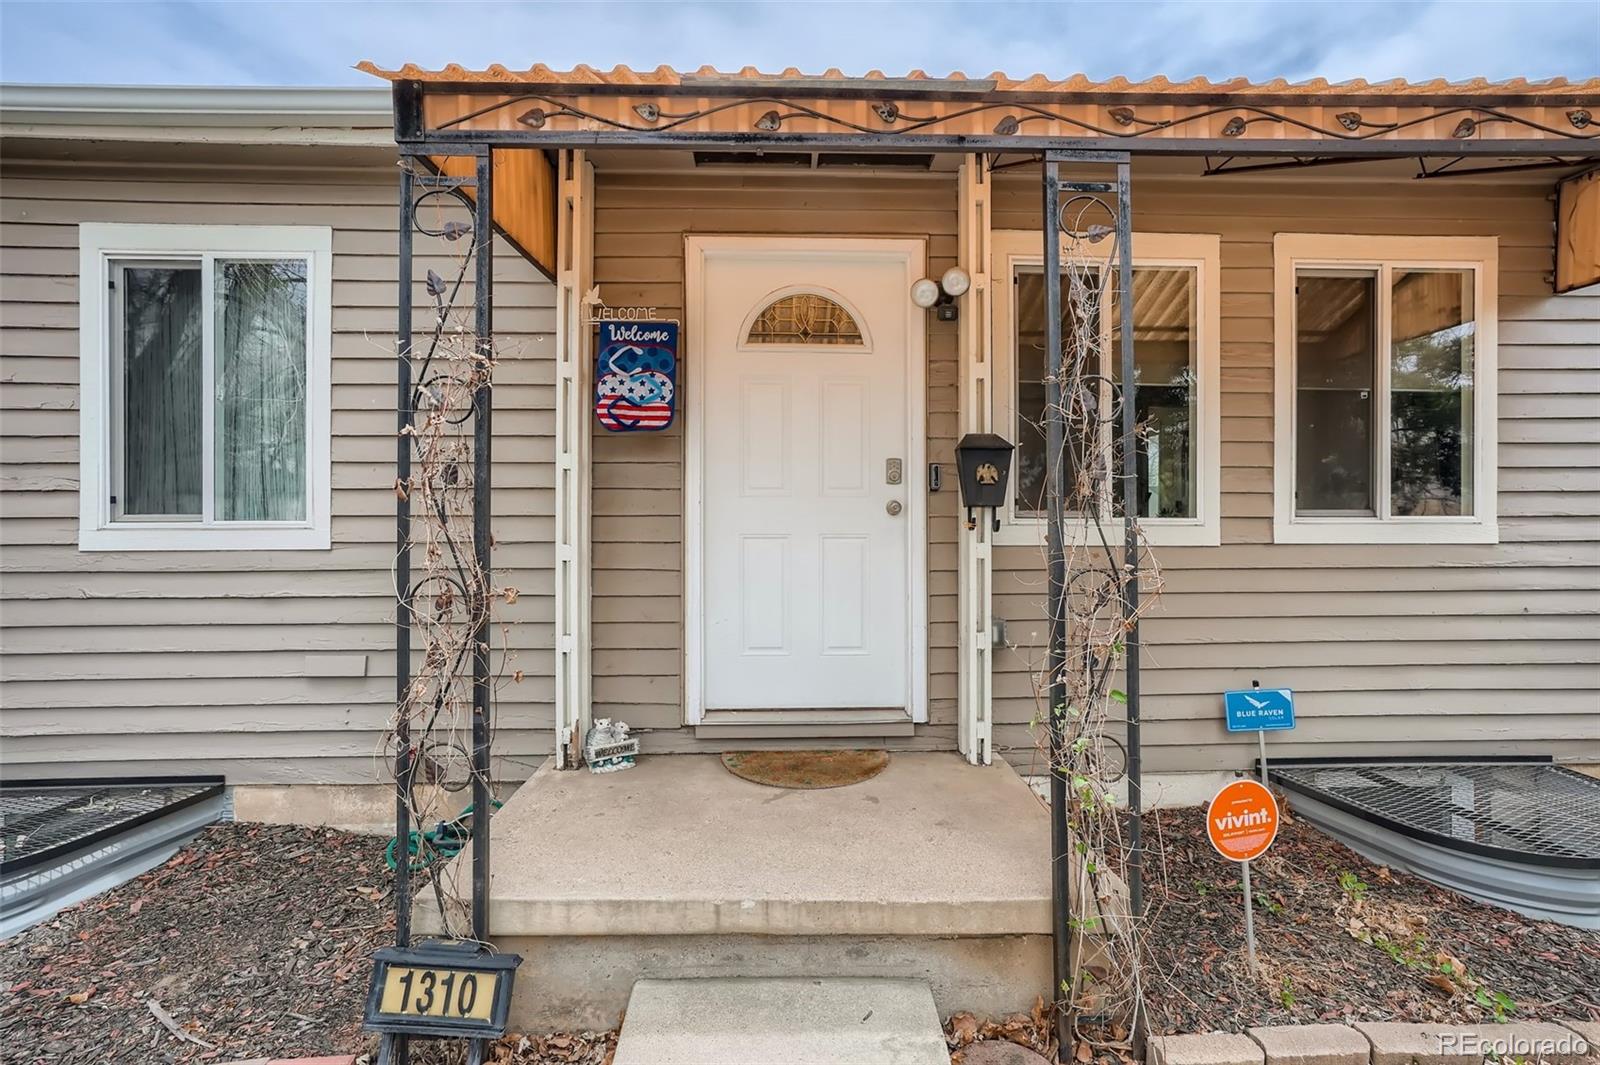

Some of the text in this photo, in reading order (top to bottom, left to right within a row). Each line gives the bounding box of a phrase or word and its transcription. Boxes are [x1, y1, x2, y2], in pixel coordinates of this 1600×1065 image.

[608, 324, 669, 342] Welcome
[1215, 807, 1272, 831] vivint.
[400, 970, 478, 1017] 1310
